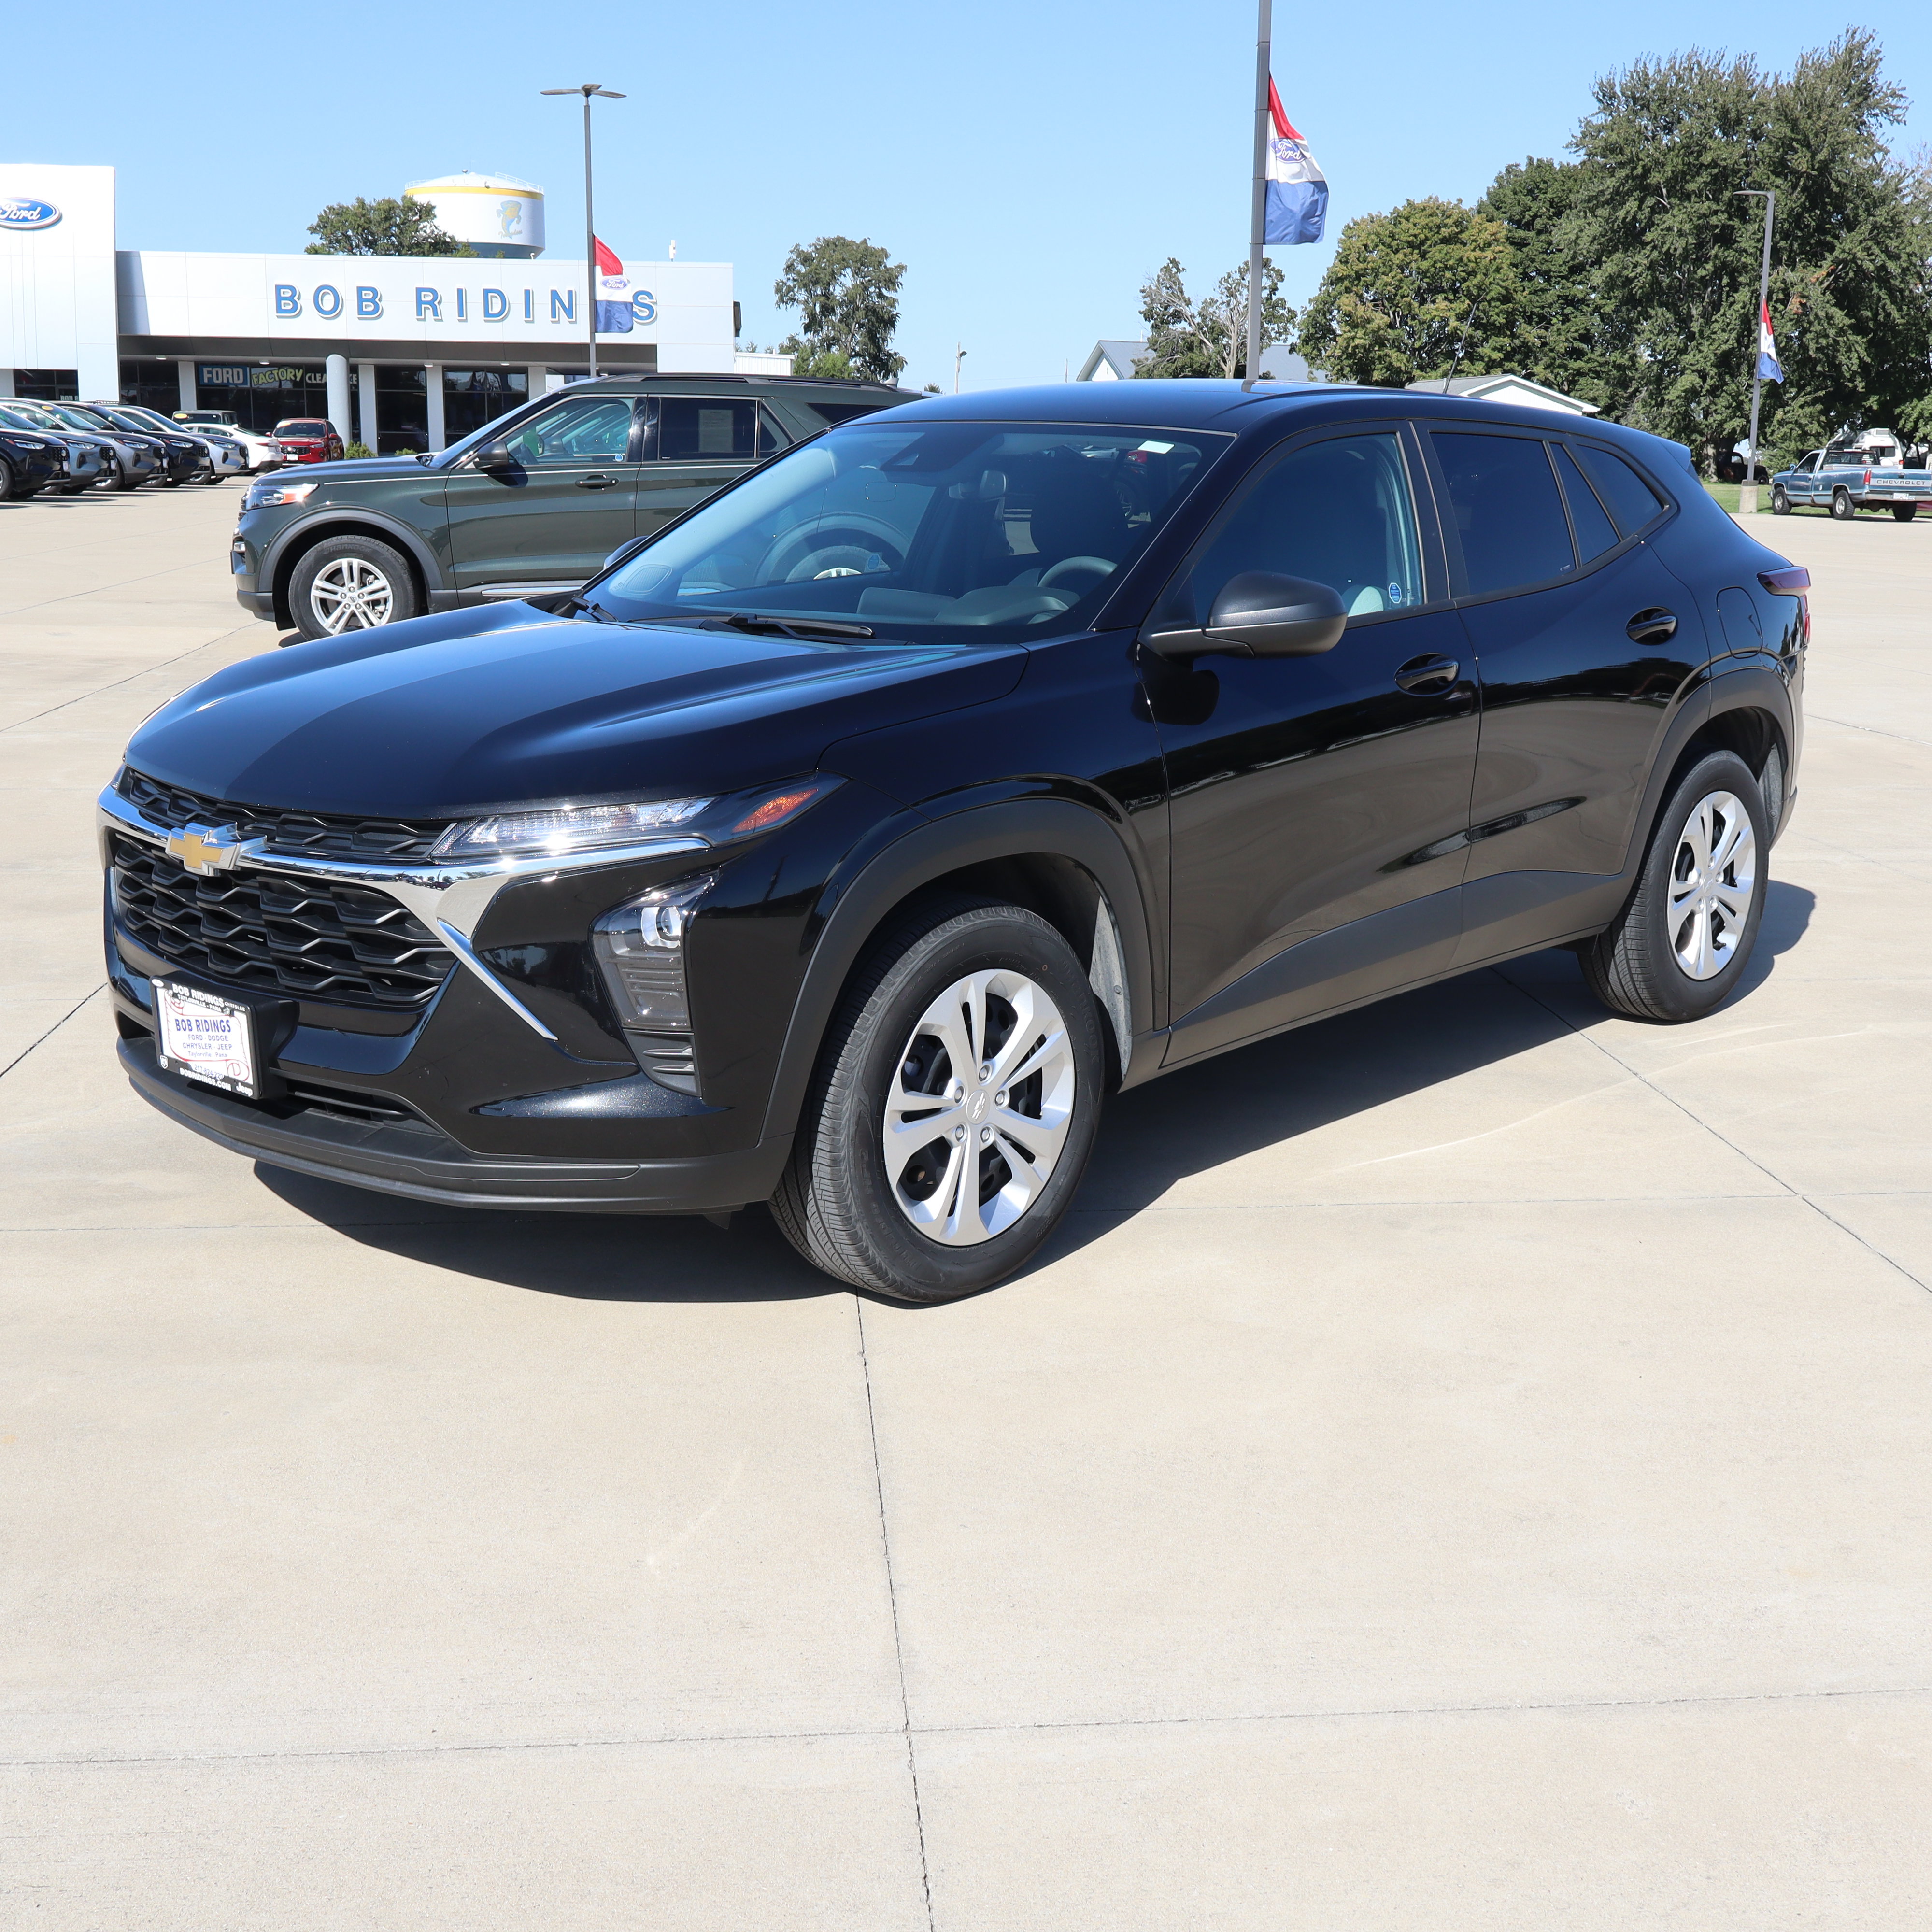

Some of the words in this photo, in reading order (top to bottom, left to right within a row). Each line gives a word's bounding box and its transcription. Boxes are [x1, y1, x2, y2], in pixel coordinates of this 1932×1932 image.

[1275, 141, 1302, 160] Ford
[0, 201, 42, 220] Ford
[606, 279, 625, 288] Ford
[274, 284, 383, 319] BOB
[414, 286, 657, 324] RIDINS
[203, 368, 243, 383] FORD
[252, 368, 303, 385] FACTORY
[306, 373, 357, 384] CLEACE
[172, 983, 190, 996] BOB
[191, 989, 225, 1008] RIDINGS
[177, 994, 206, 1008] TAYLORVILLE
[209, 1004, 222, 1013] PANA
[225, 1001, 245, 1011] CHRYSLER
[175, 1019, 193, 1032] BOB
[195, 1019, 231, 1033] RIDINGS
[180, 1067, 231, 1092] BOBRIDINGS.COM
[236, 1082, 253, 1097] Jeep
